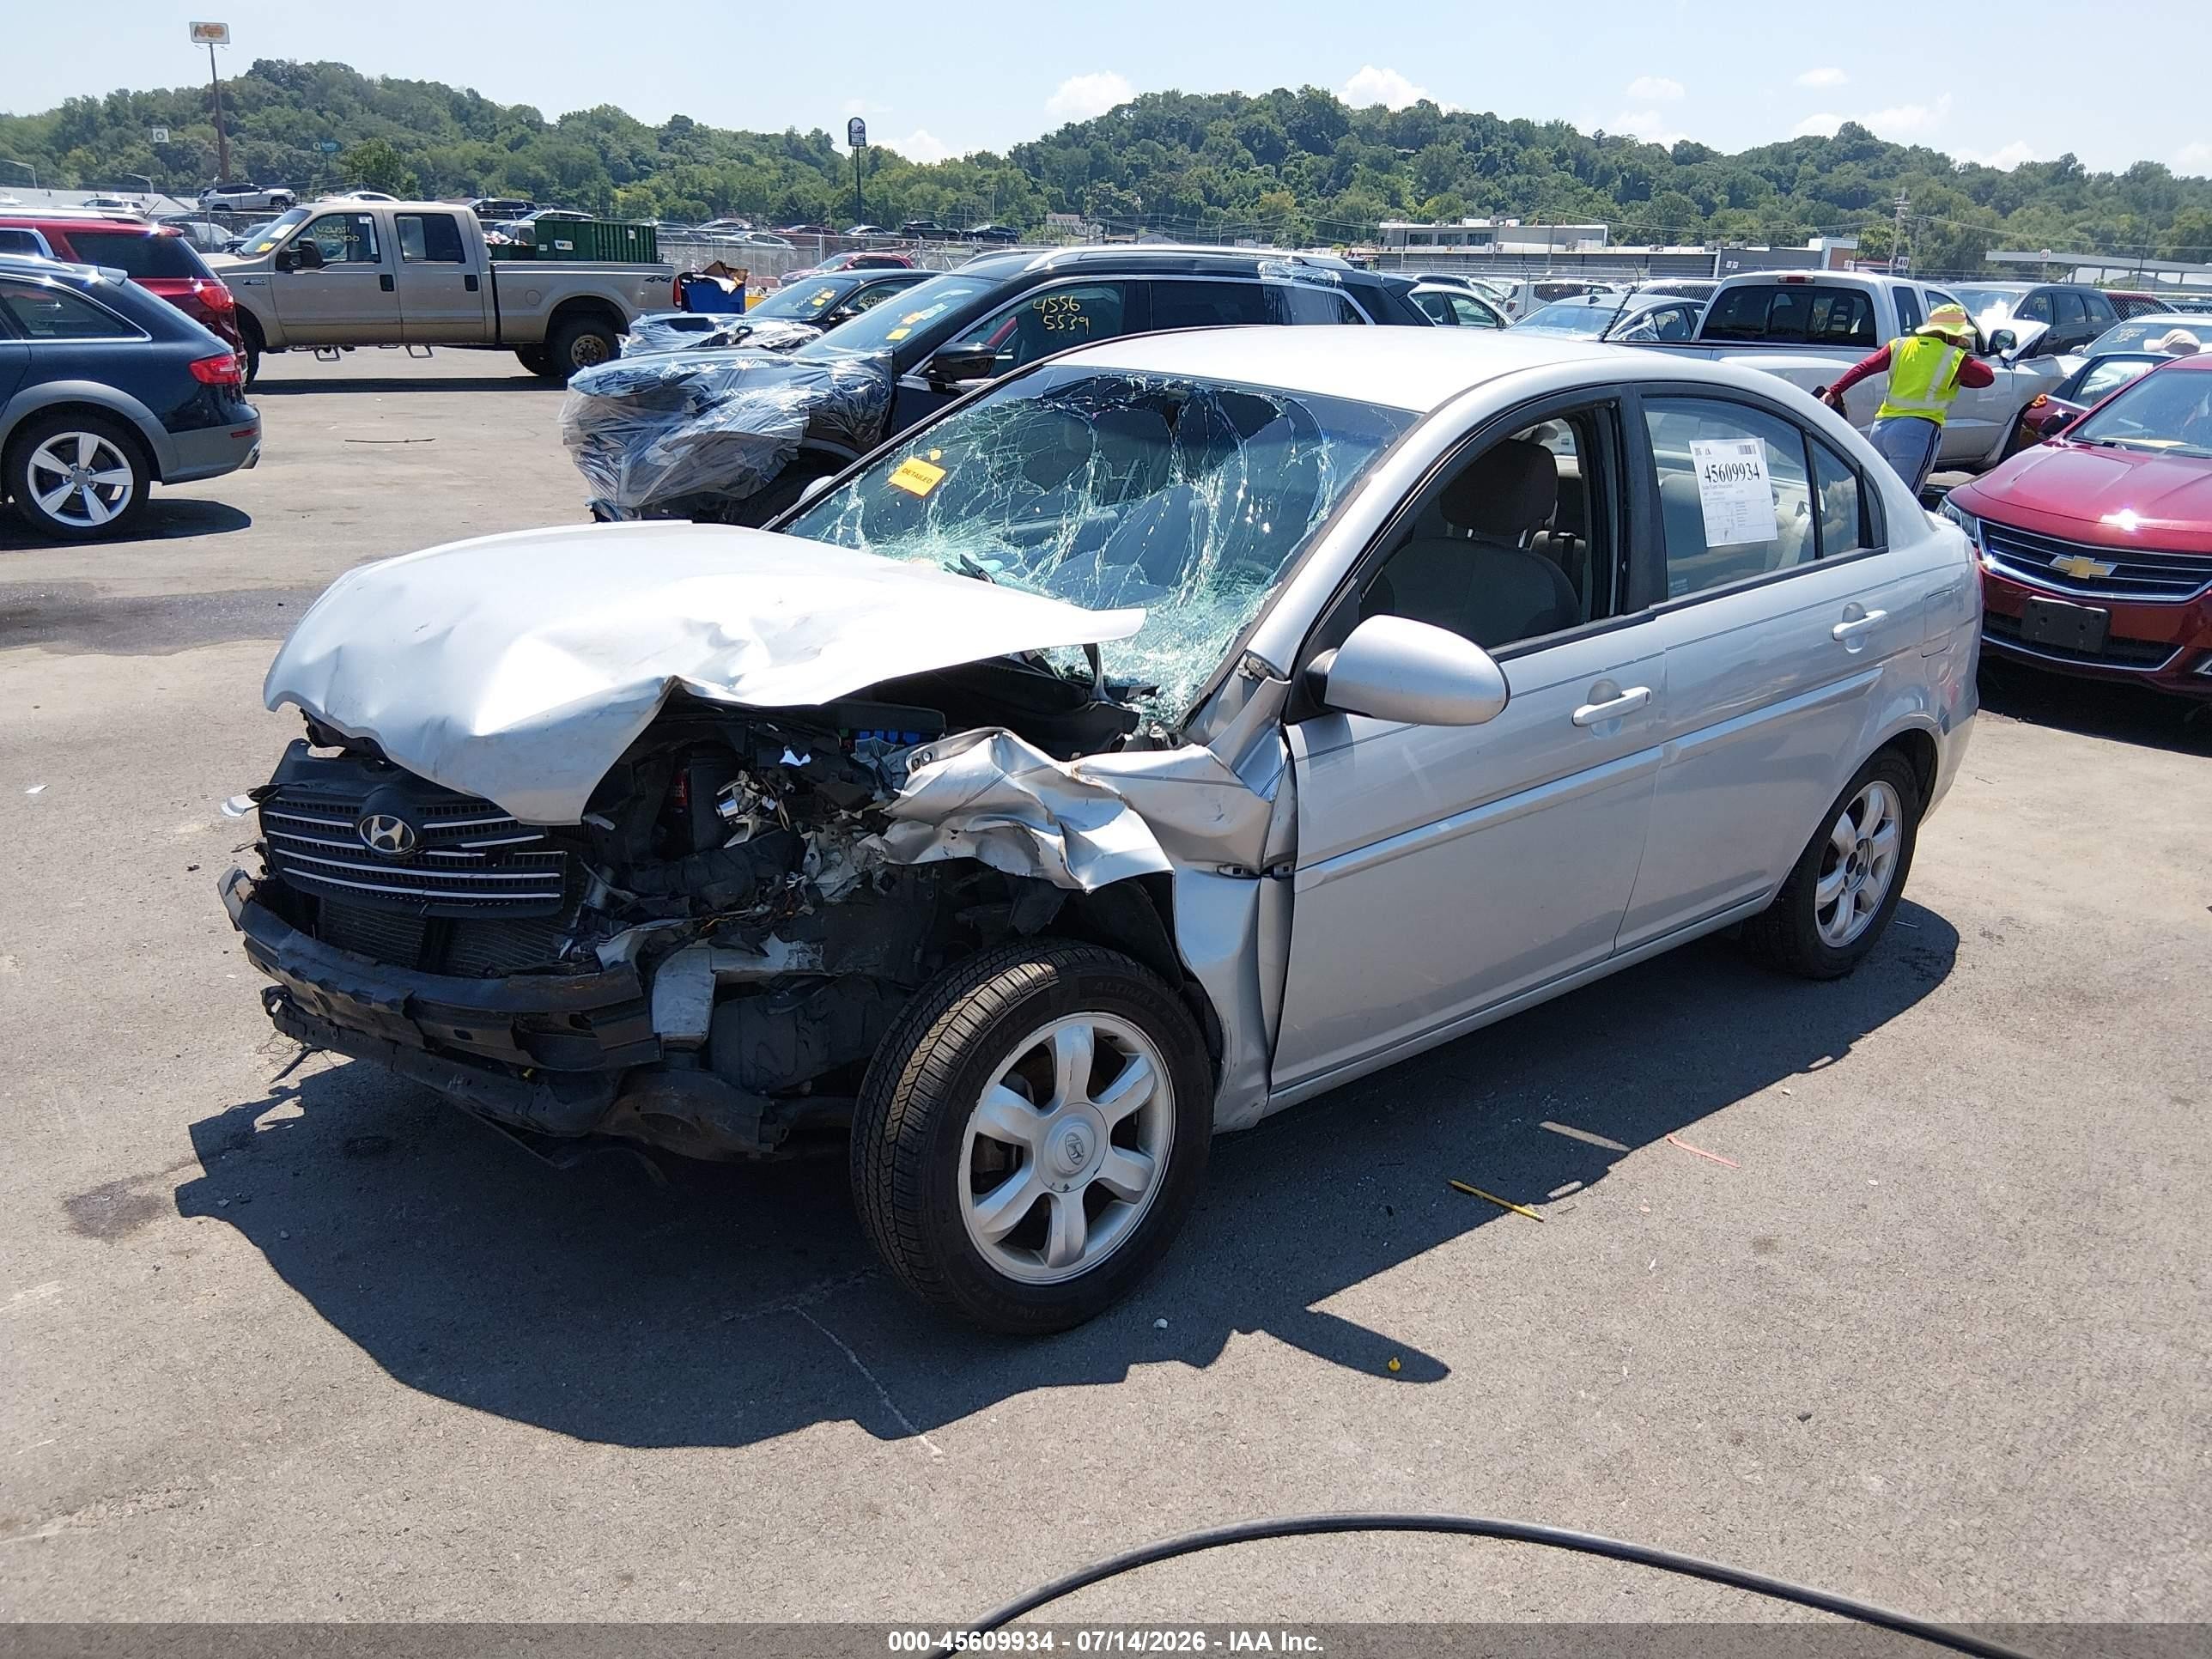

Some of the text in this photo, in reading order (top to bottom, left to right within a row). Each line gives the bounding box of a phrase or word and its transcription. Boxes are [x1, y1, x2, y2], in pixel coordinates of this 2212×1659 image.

[1032, 295, 1081, 314] 4556
[1042, 313, 1090, 336] 5539
[901, 467, 933, 484] DETAILED
[1704, 460, 1760, 483] 45609934
